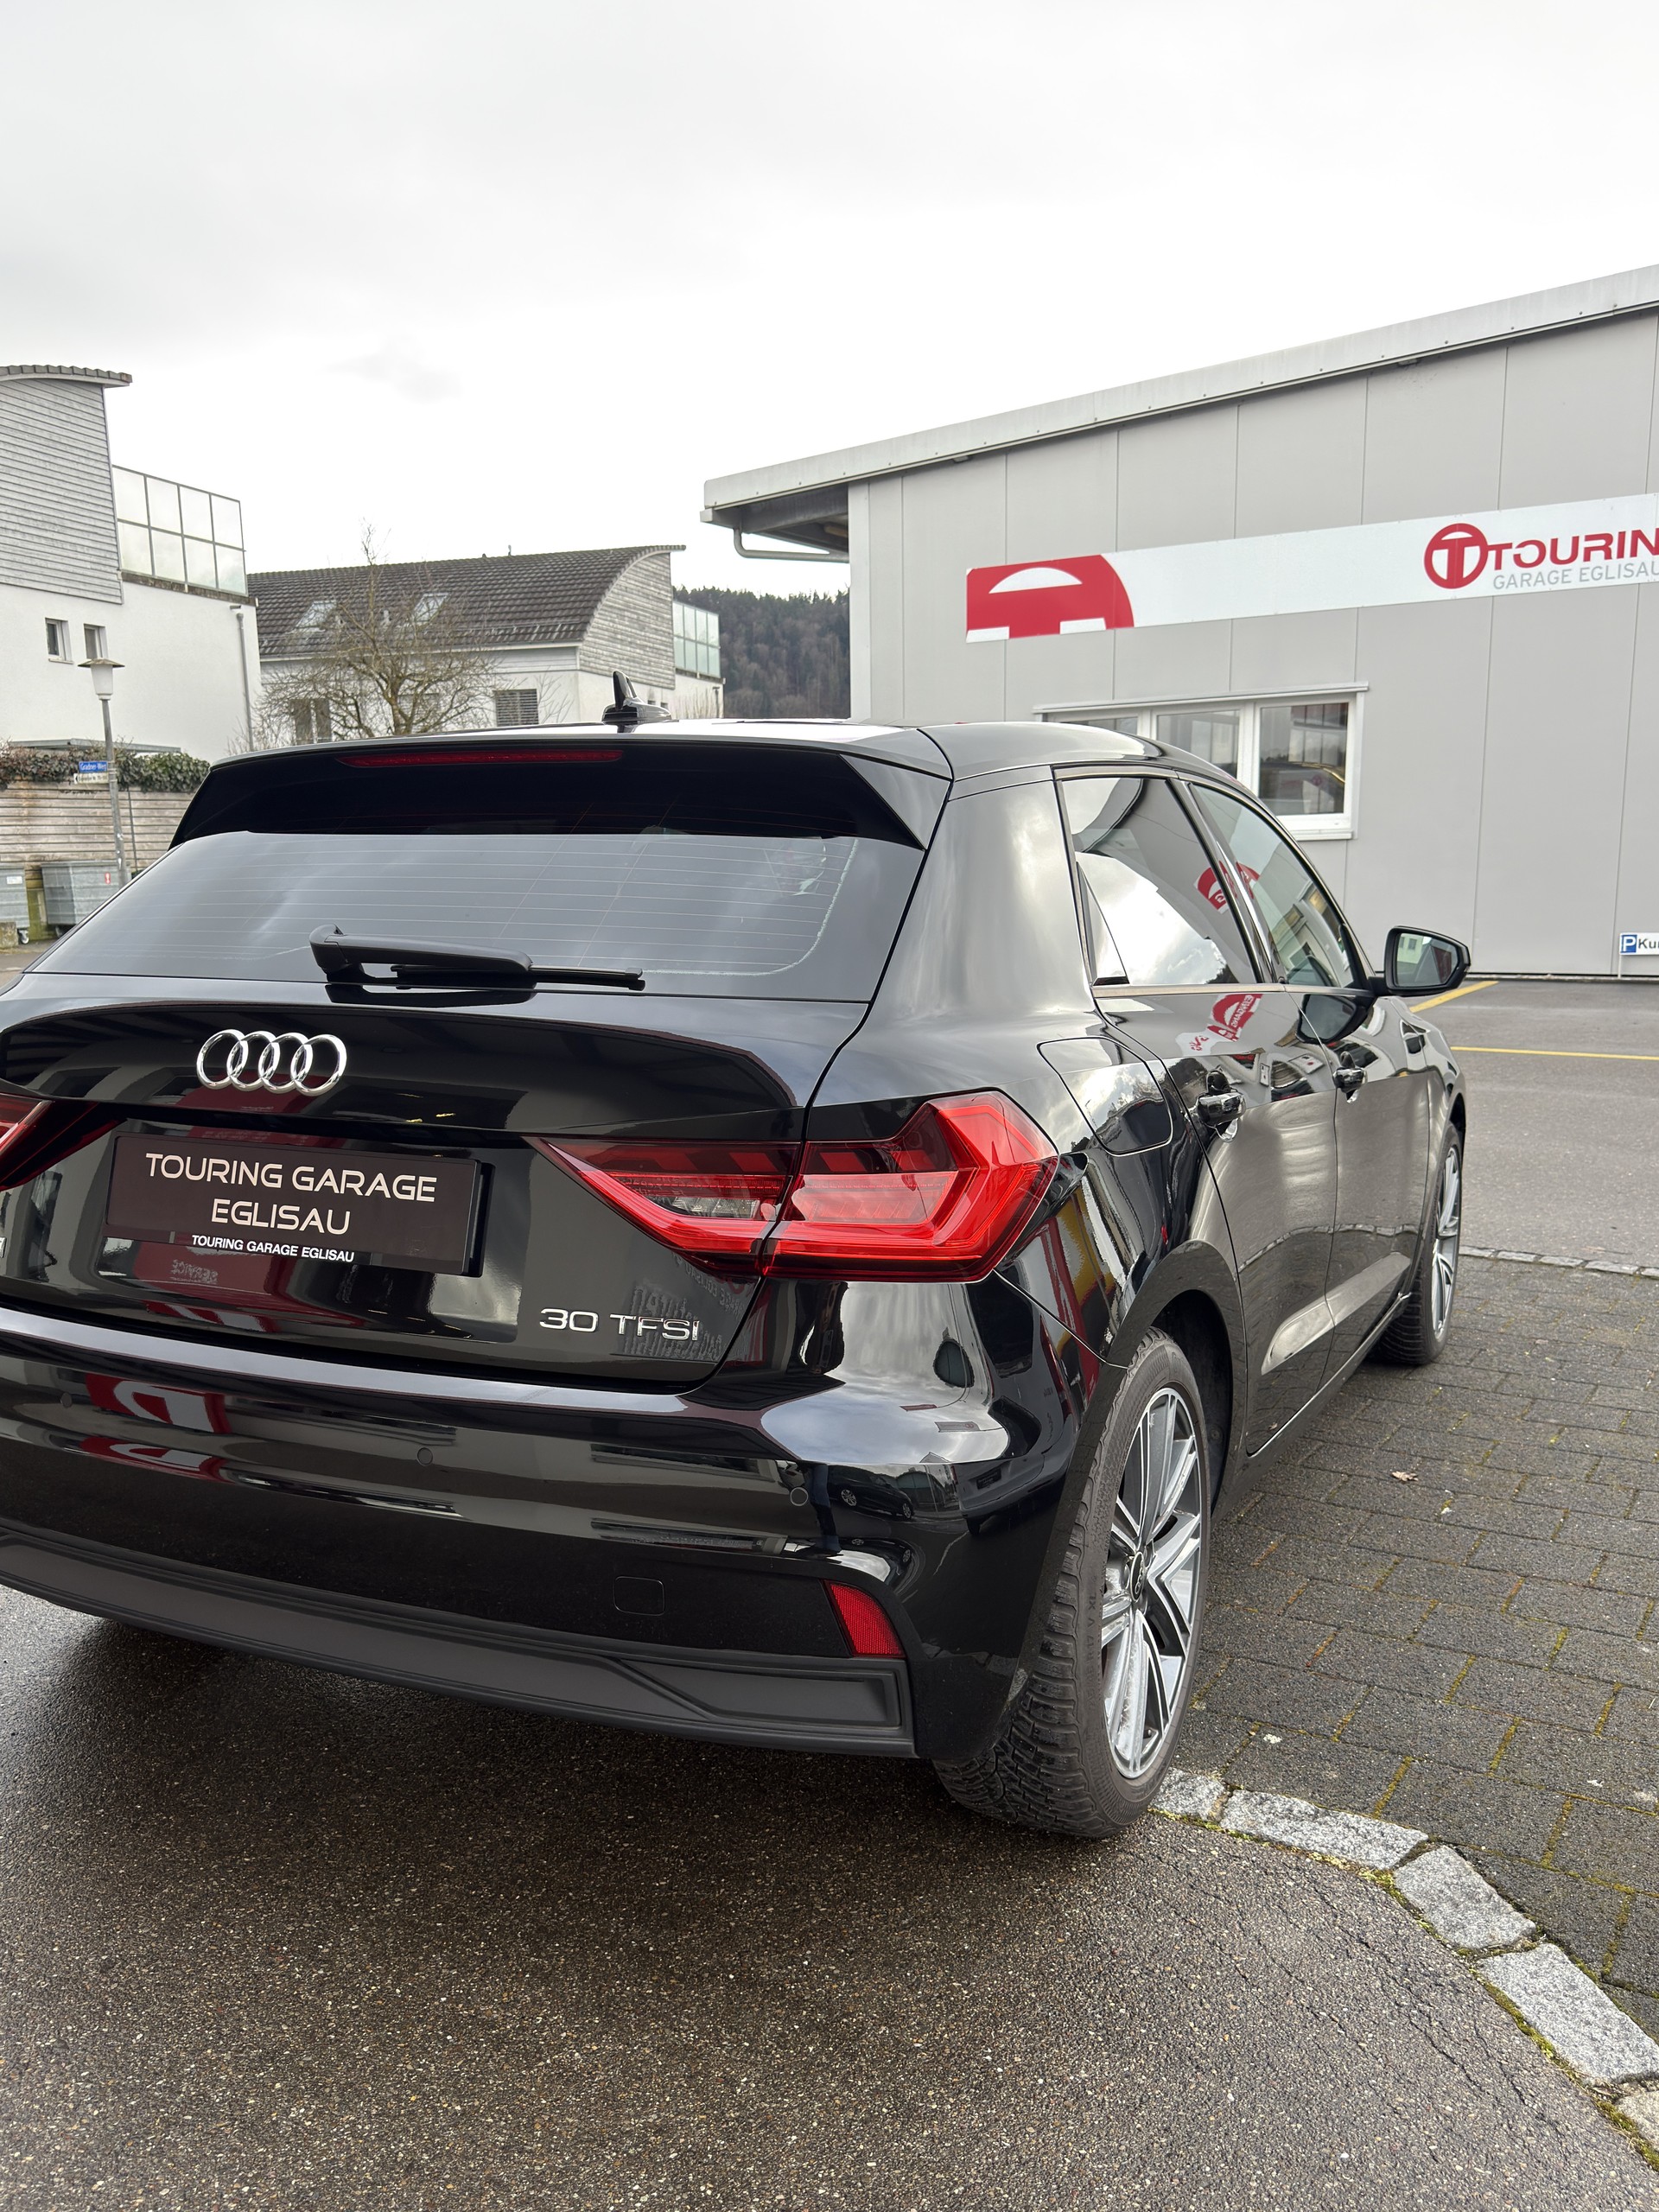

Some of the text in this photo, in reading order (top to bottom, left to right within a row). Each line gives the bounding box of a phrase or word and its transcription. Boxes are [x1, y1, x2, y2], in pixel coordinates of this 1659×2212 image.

[1492, 569, 1572, 590] GARAGE
[1638, 938, 1659, 950] Ku
[145, 1153, 437, 1203] TOURING GARAGE
[211, 1198, 351, 1236] EGLISAU
[192, 1234, 355, 1262] TOURING GARAGE EGLISAU
[538, 1307, 700, 1341] 30 TFSI
